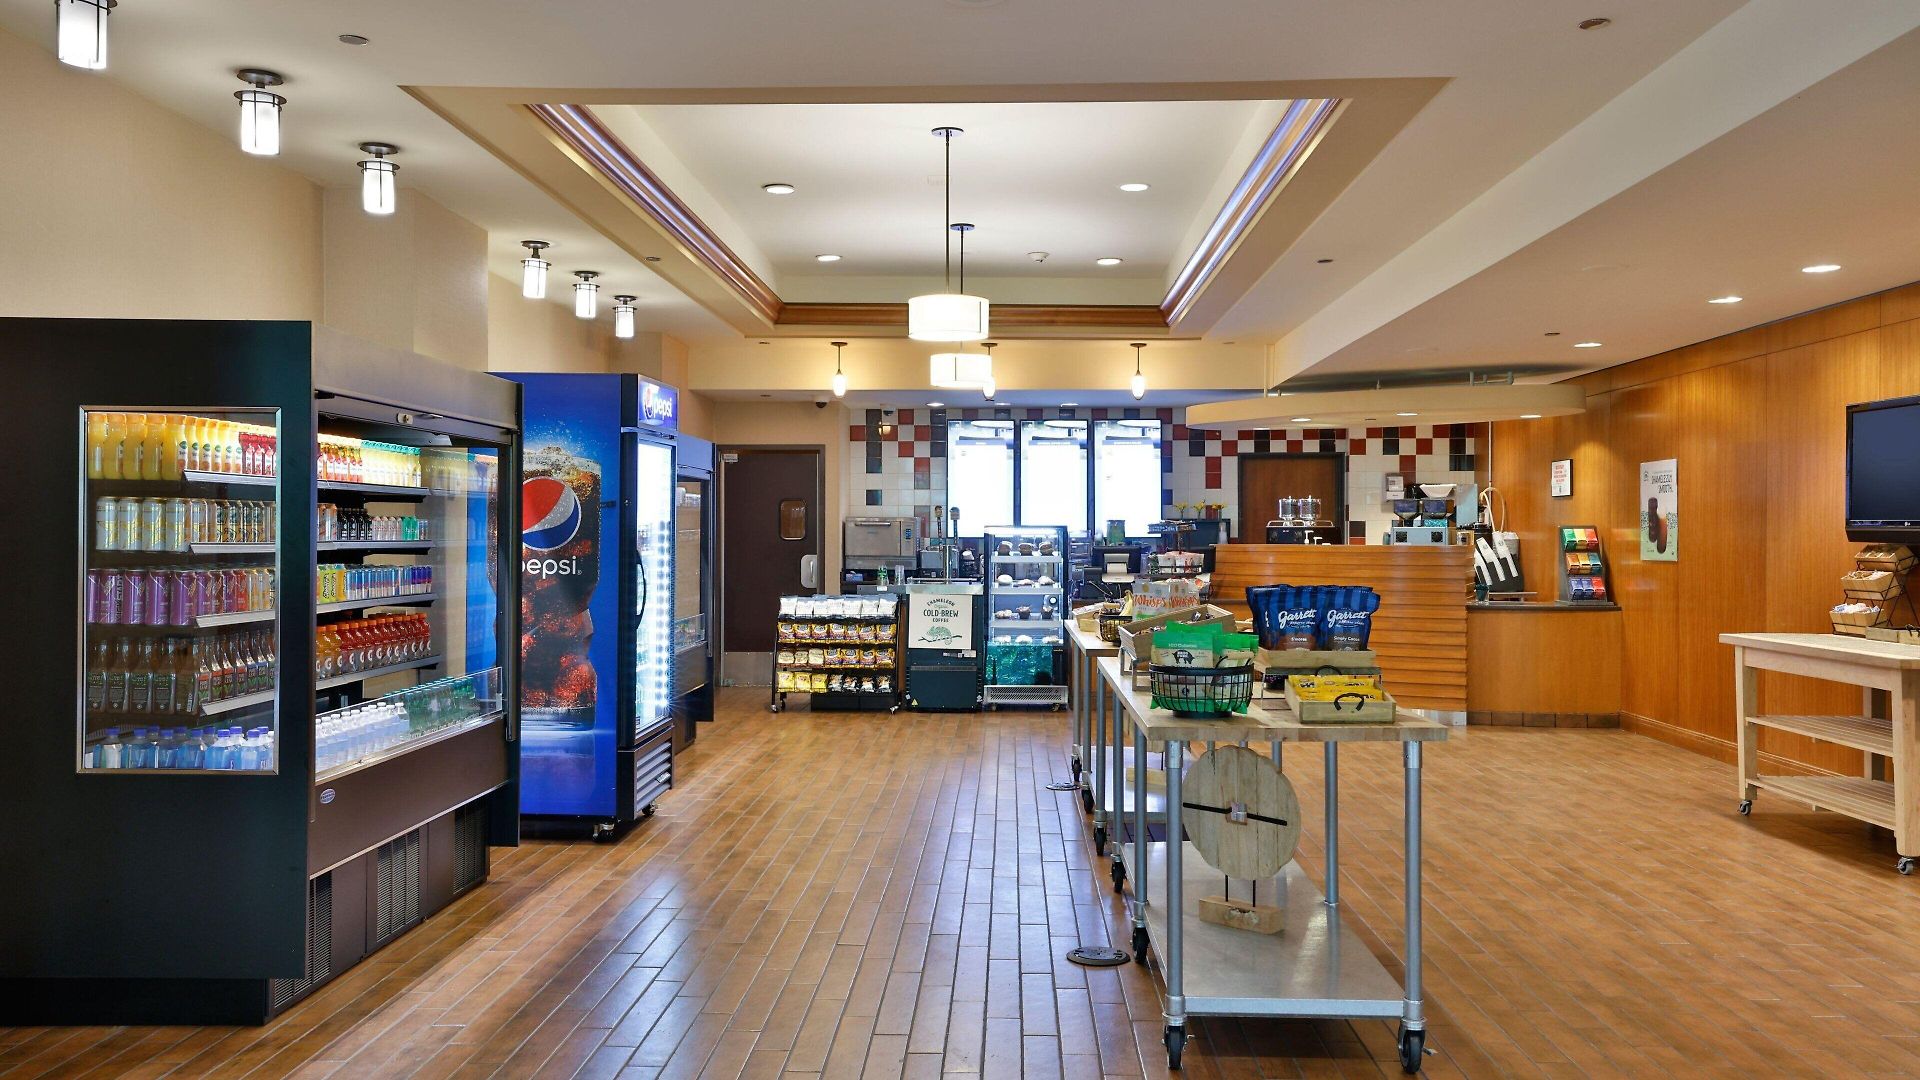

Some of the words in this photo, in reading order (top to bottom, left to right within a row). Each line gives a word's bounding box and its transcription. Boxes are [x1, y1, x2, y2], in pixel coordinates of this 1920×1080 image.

[653, 397, 672, 420] pepsi
[927, 598, 955, 607] CHAMELEON
[923, 609, 959, 617] COLD-BREW
[1278, 609, 1317, 629] Garrett
[1327, 609, 1369, 629] Garrett
